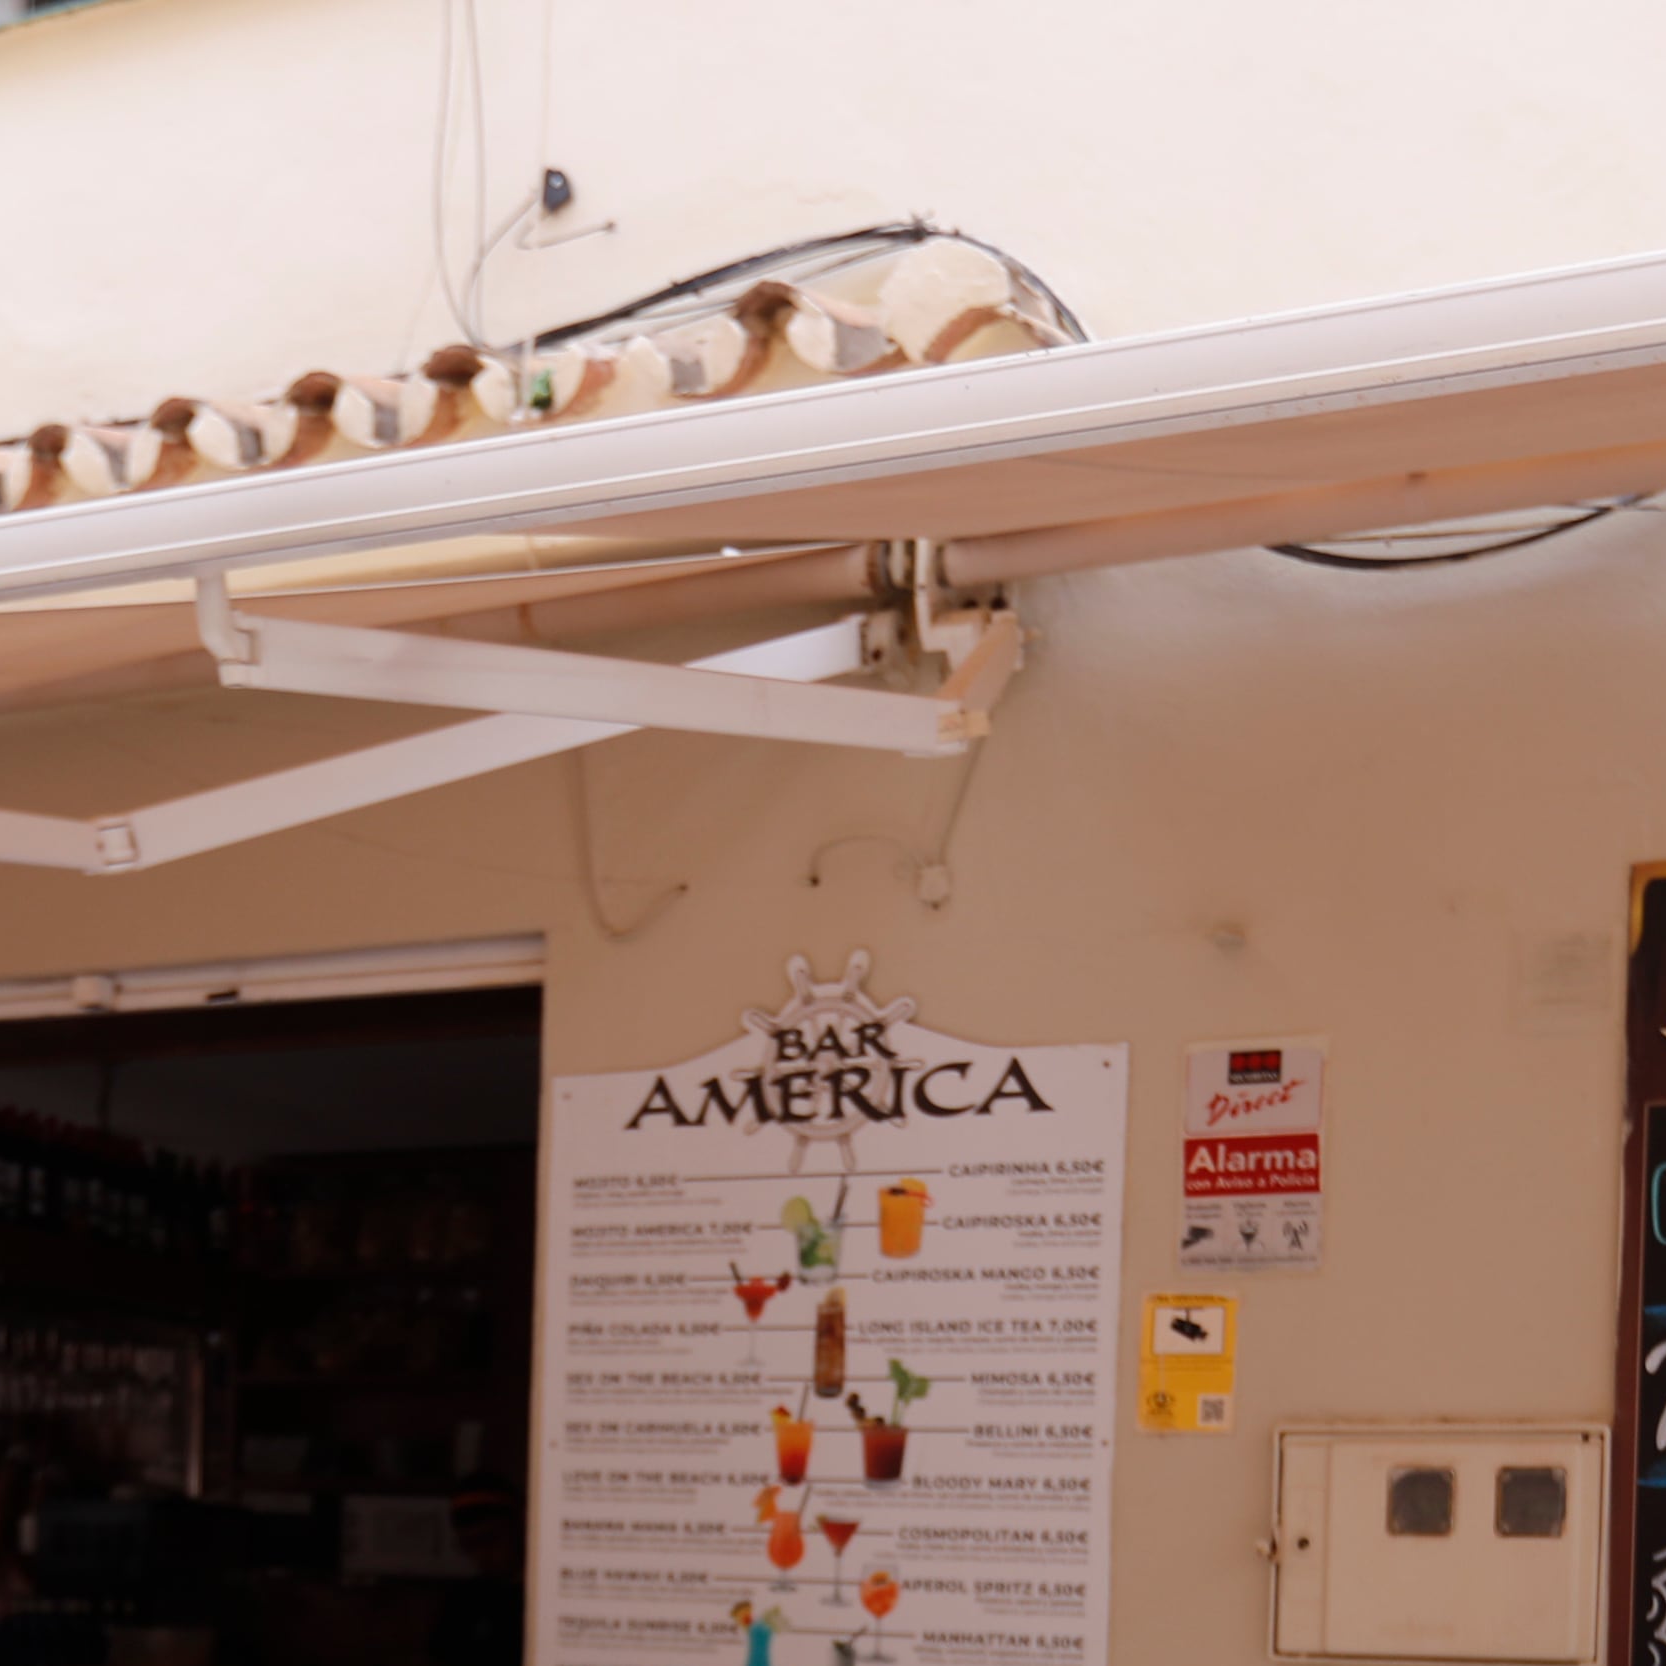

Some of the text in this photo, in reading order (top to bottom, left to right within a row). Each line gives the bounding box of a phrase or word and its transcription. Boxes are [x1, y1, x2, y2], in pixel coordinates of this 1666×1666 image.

[772, 1022, 897, 1062] BAR
[624, 1056, 1055, 1130] AMERICA
[1188, 1142, 1317, 1173] Alarma
[949, 1160, 1104, 1177] CAIPIRINHA 6,50€
[1186, 1180, 1211, 1191] con
[942, 1212, 1102, 1231] CAIPIROSKA 6,50€
[871, 1266, 1101, 1283] CAIPIROSKA MANGO 6,50€
[858, 1319, 1098, 1334] LONG ISLAND ICE TEA 7,00€
[971, 1372, 1096, 1387] MIMOSA 6,50€
[973, 1425, 1093, 1440] BELLINI 6,50€
[911, 1476, 1091, 1493] BLOODY MARY 6,50€
[898, 1527, 1088, 1546] COSMOPOLITAN 6,50€
[902, 1579, 1087, 1598] APEROL SPRITZ 6,50€
[923, 1632, 1085, 1650] MANHATTAN 6,50€
